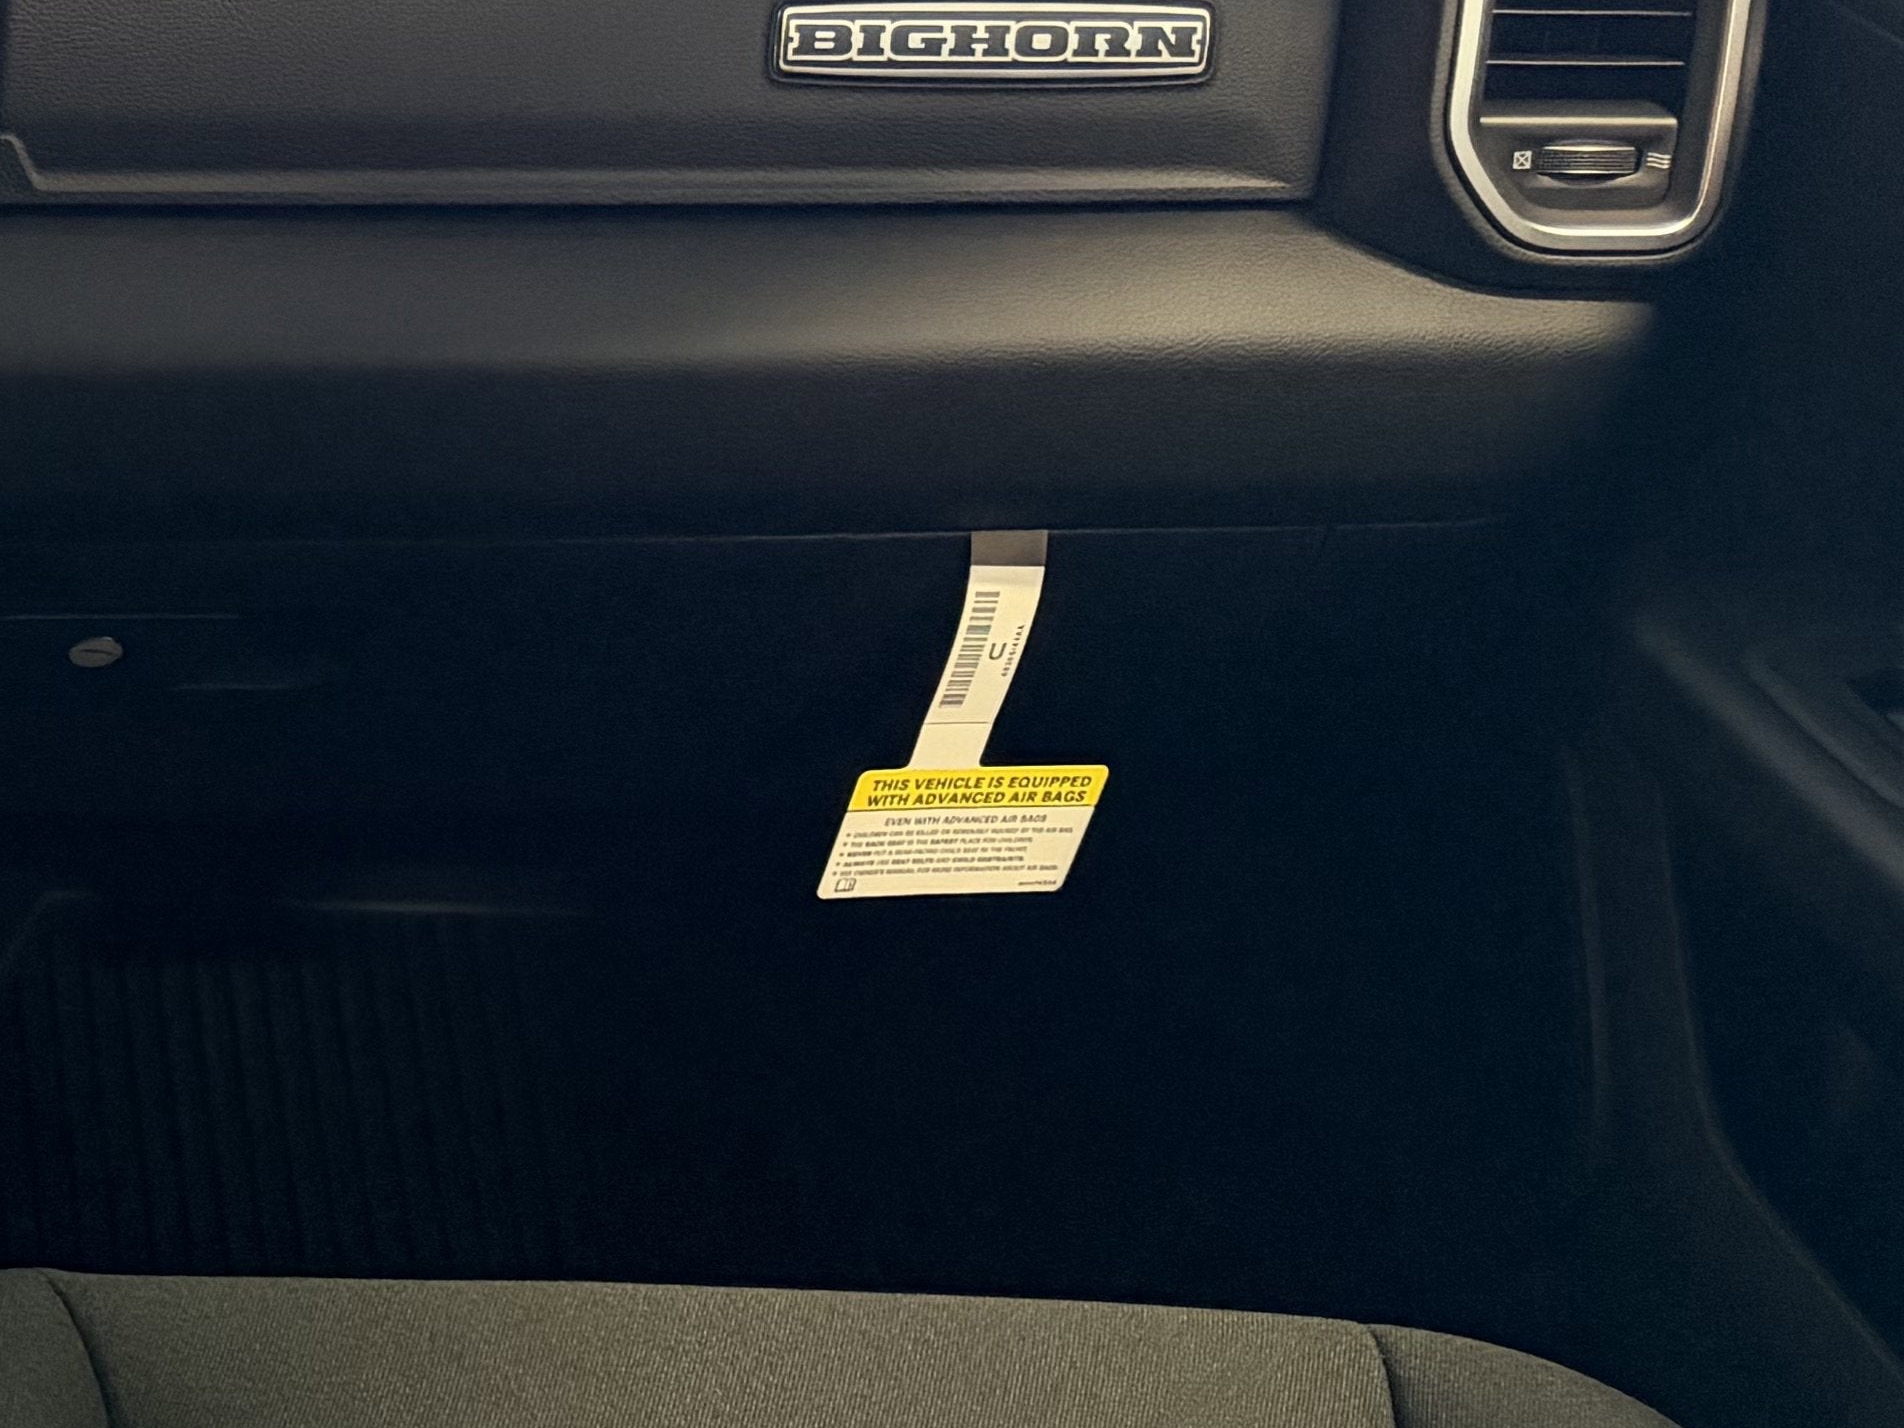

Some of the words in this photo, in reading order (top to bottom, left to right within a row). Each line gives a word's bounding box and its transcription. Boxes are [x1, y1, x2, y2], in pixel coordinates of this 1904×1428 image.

[788, 18, 1202, 63] BIGHORN
[873, 779, 910, 792] THIS
[915, 777, 982, 791] VEHICLE
[988, 776, 1004, 789] IS
[1007, 775, 1093, 789] EQUIPPED
[867, 794, 909, 807] WITH
[912, 792, 1004, 806] ADVANCED
[1008, 791, 1037, 804] AIR
[1041, 790, 1086, 803] BAGS
[884, 817, 911, 827] EVEN
[942, 815, 998, 825] ADVANCED
